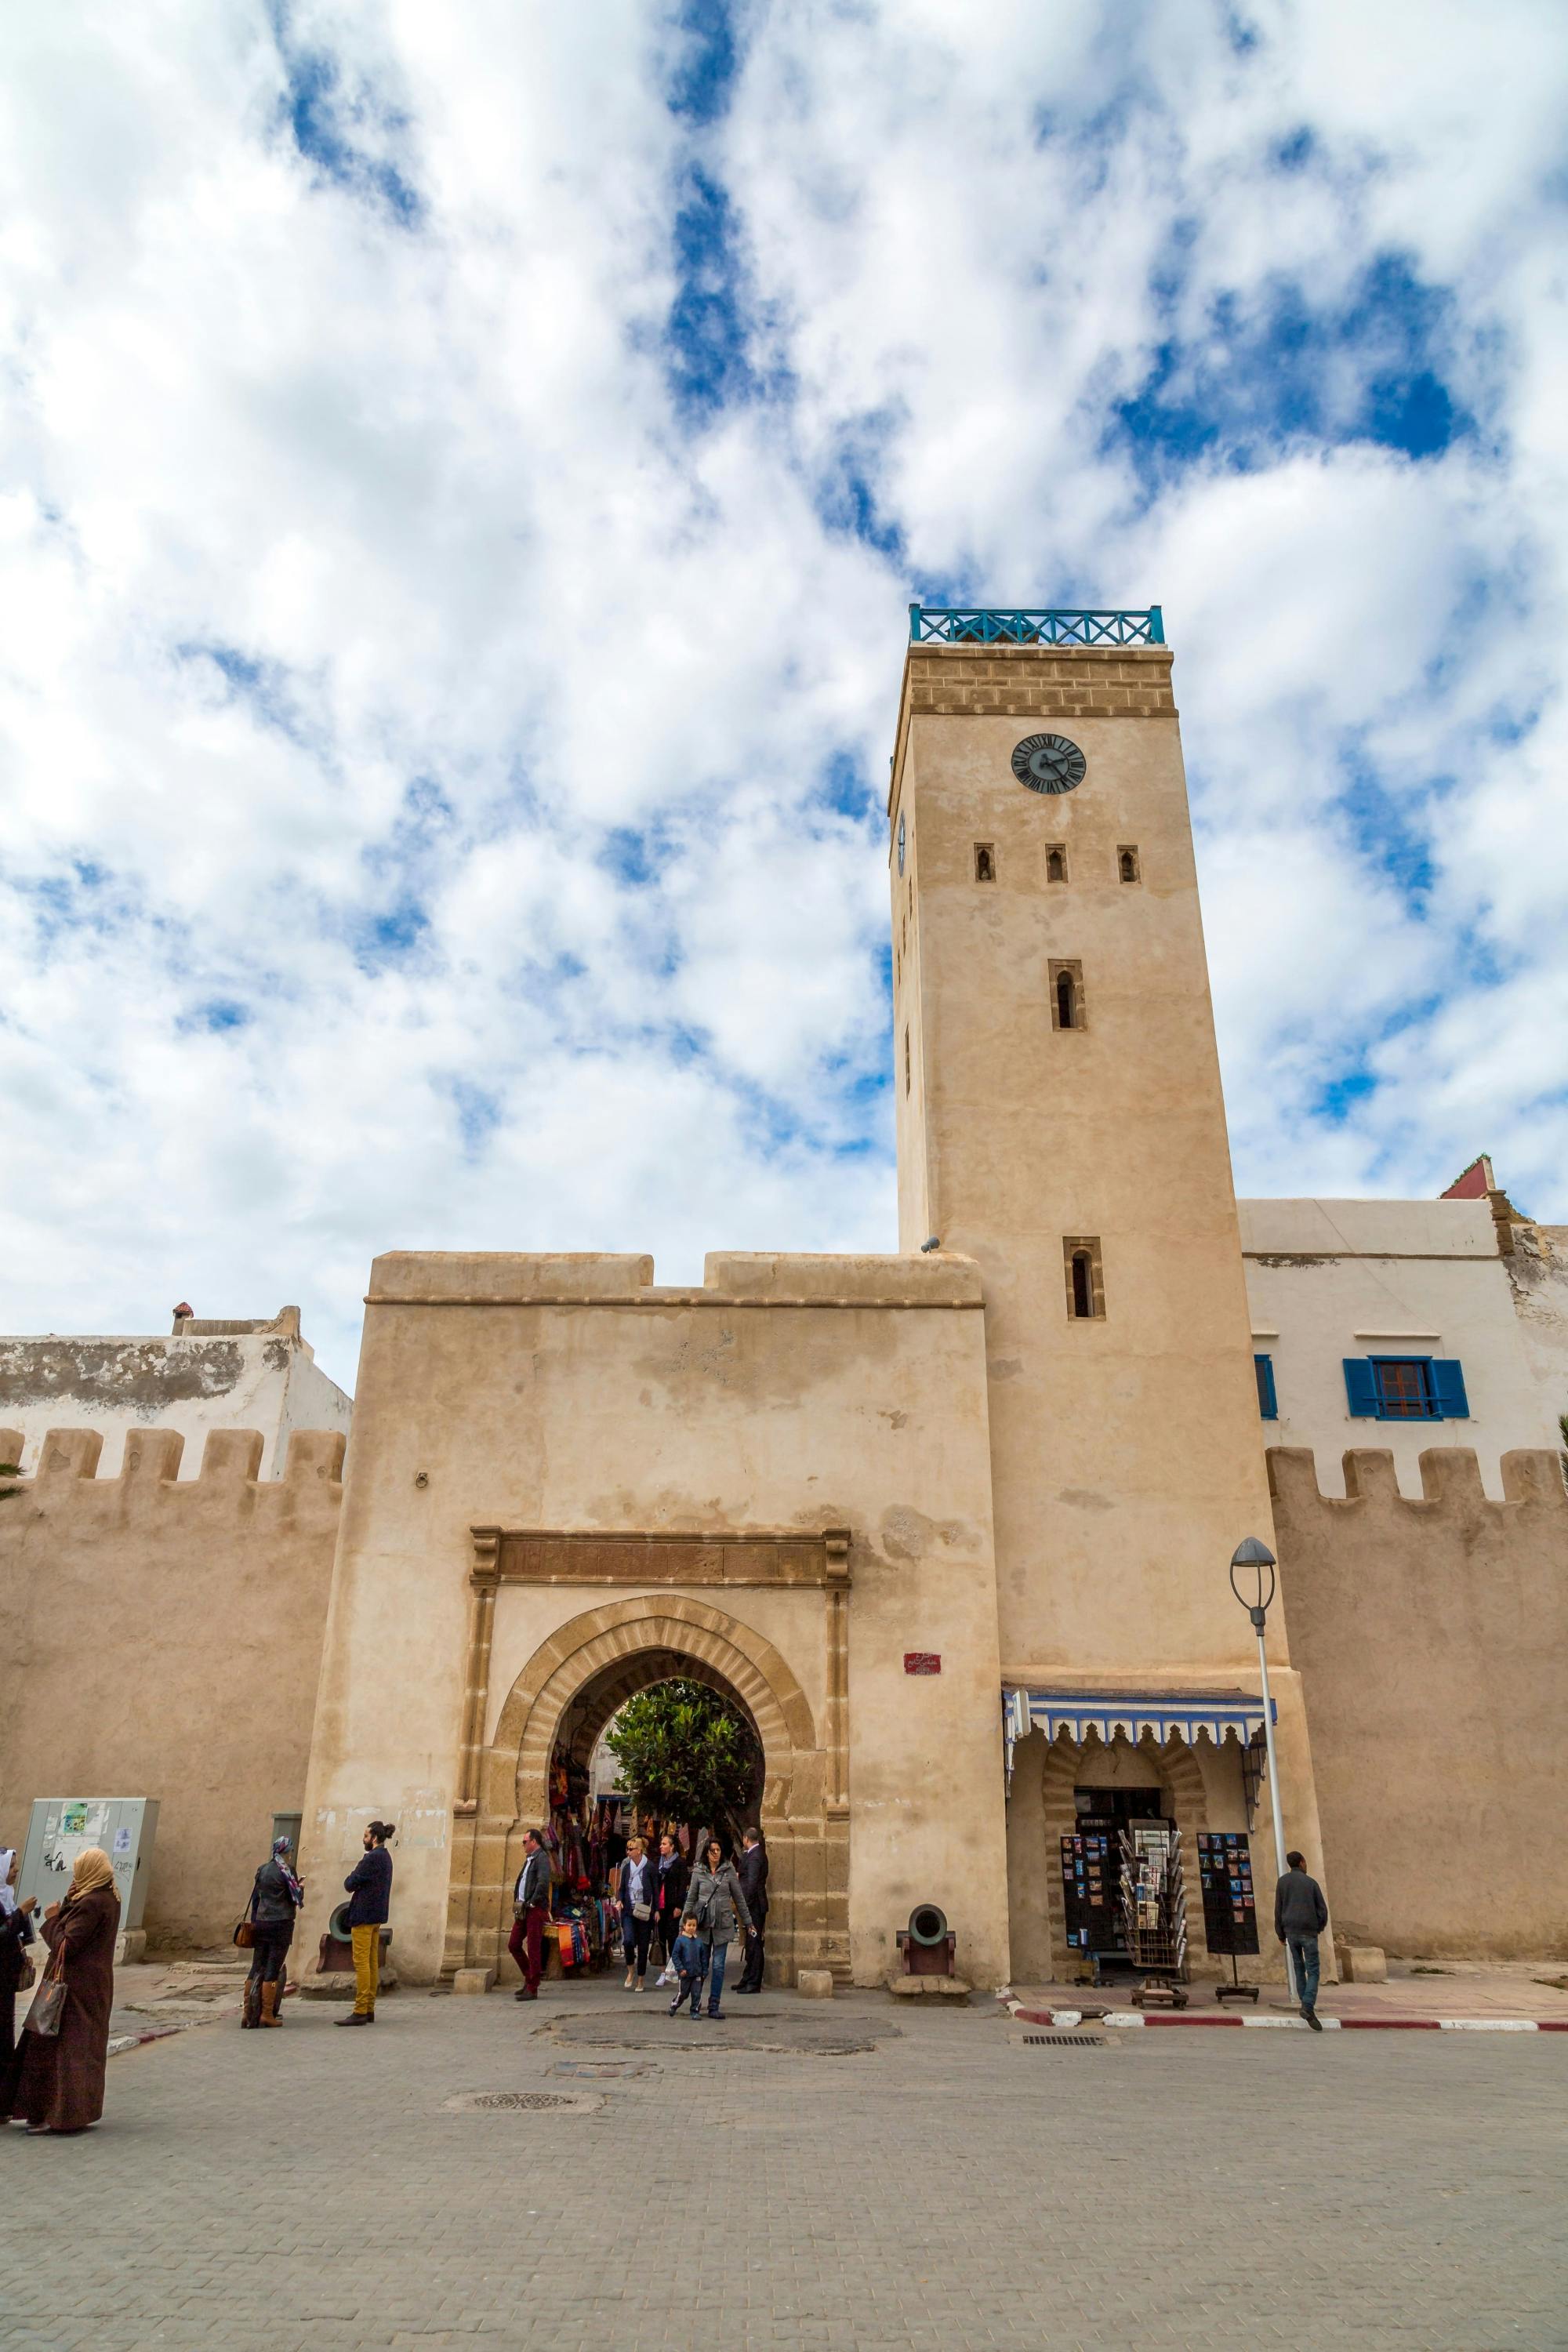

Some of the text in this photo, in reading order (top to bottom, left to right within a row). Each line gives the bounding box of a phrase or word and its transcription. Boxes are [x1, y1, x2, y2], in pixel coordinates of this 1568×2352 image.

[1026, 738, 1040, 749] XI
[1042, 735, 1052, 746] XII
[1047, 781, 1055, 793] VI
